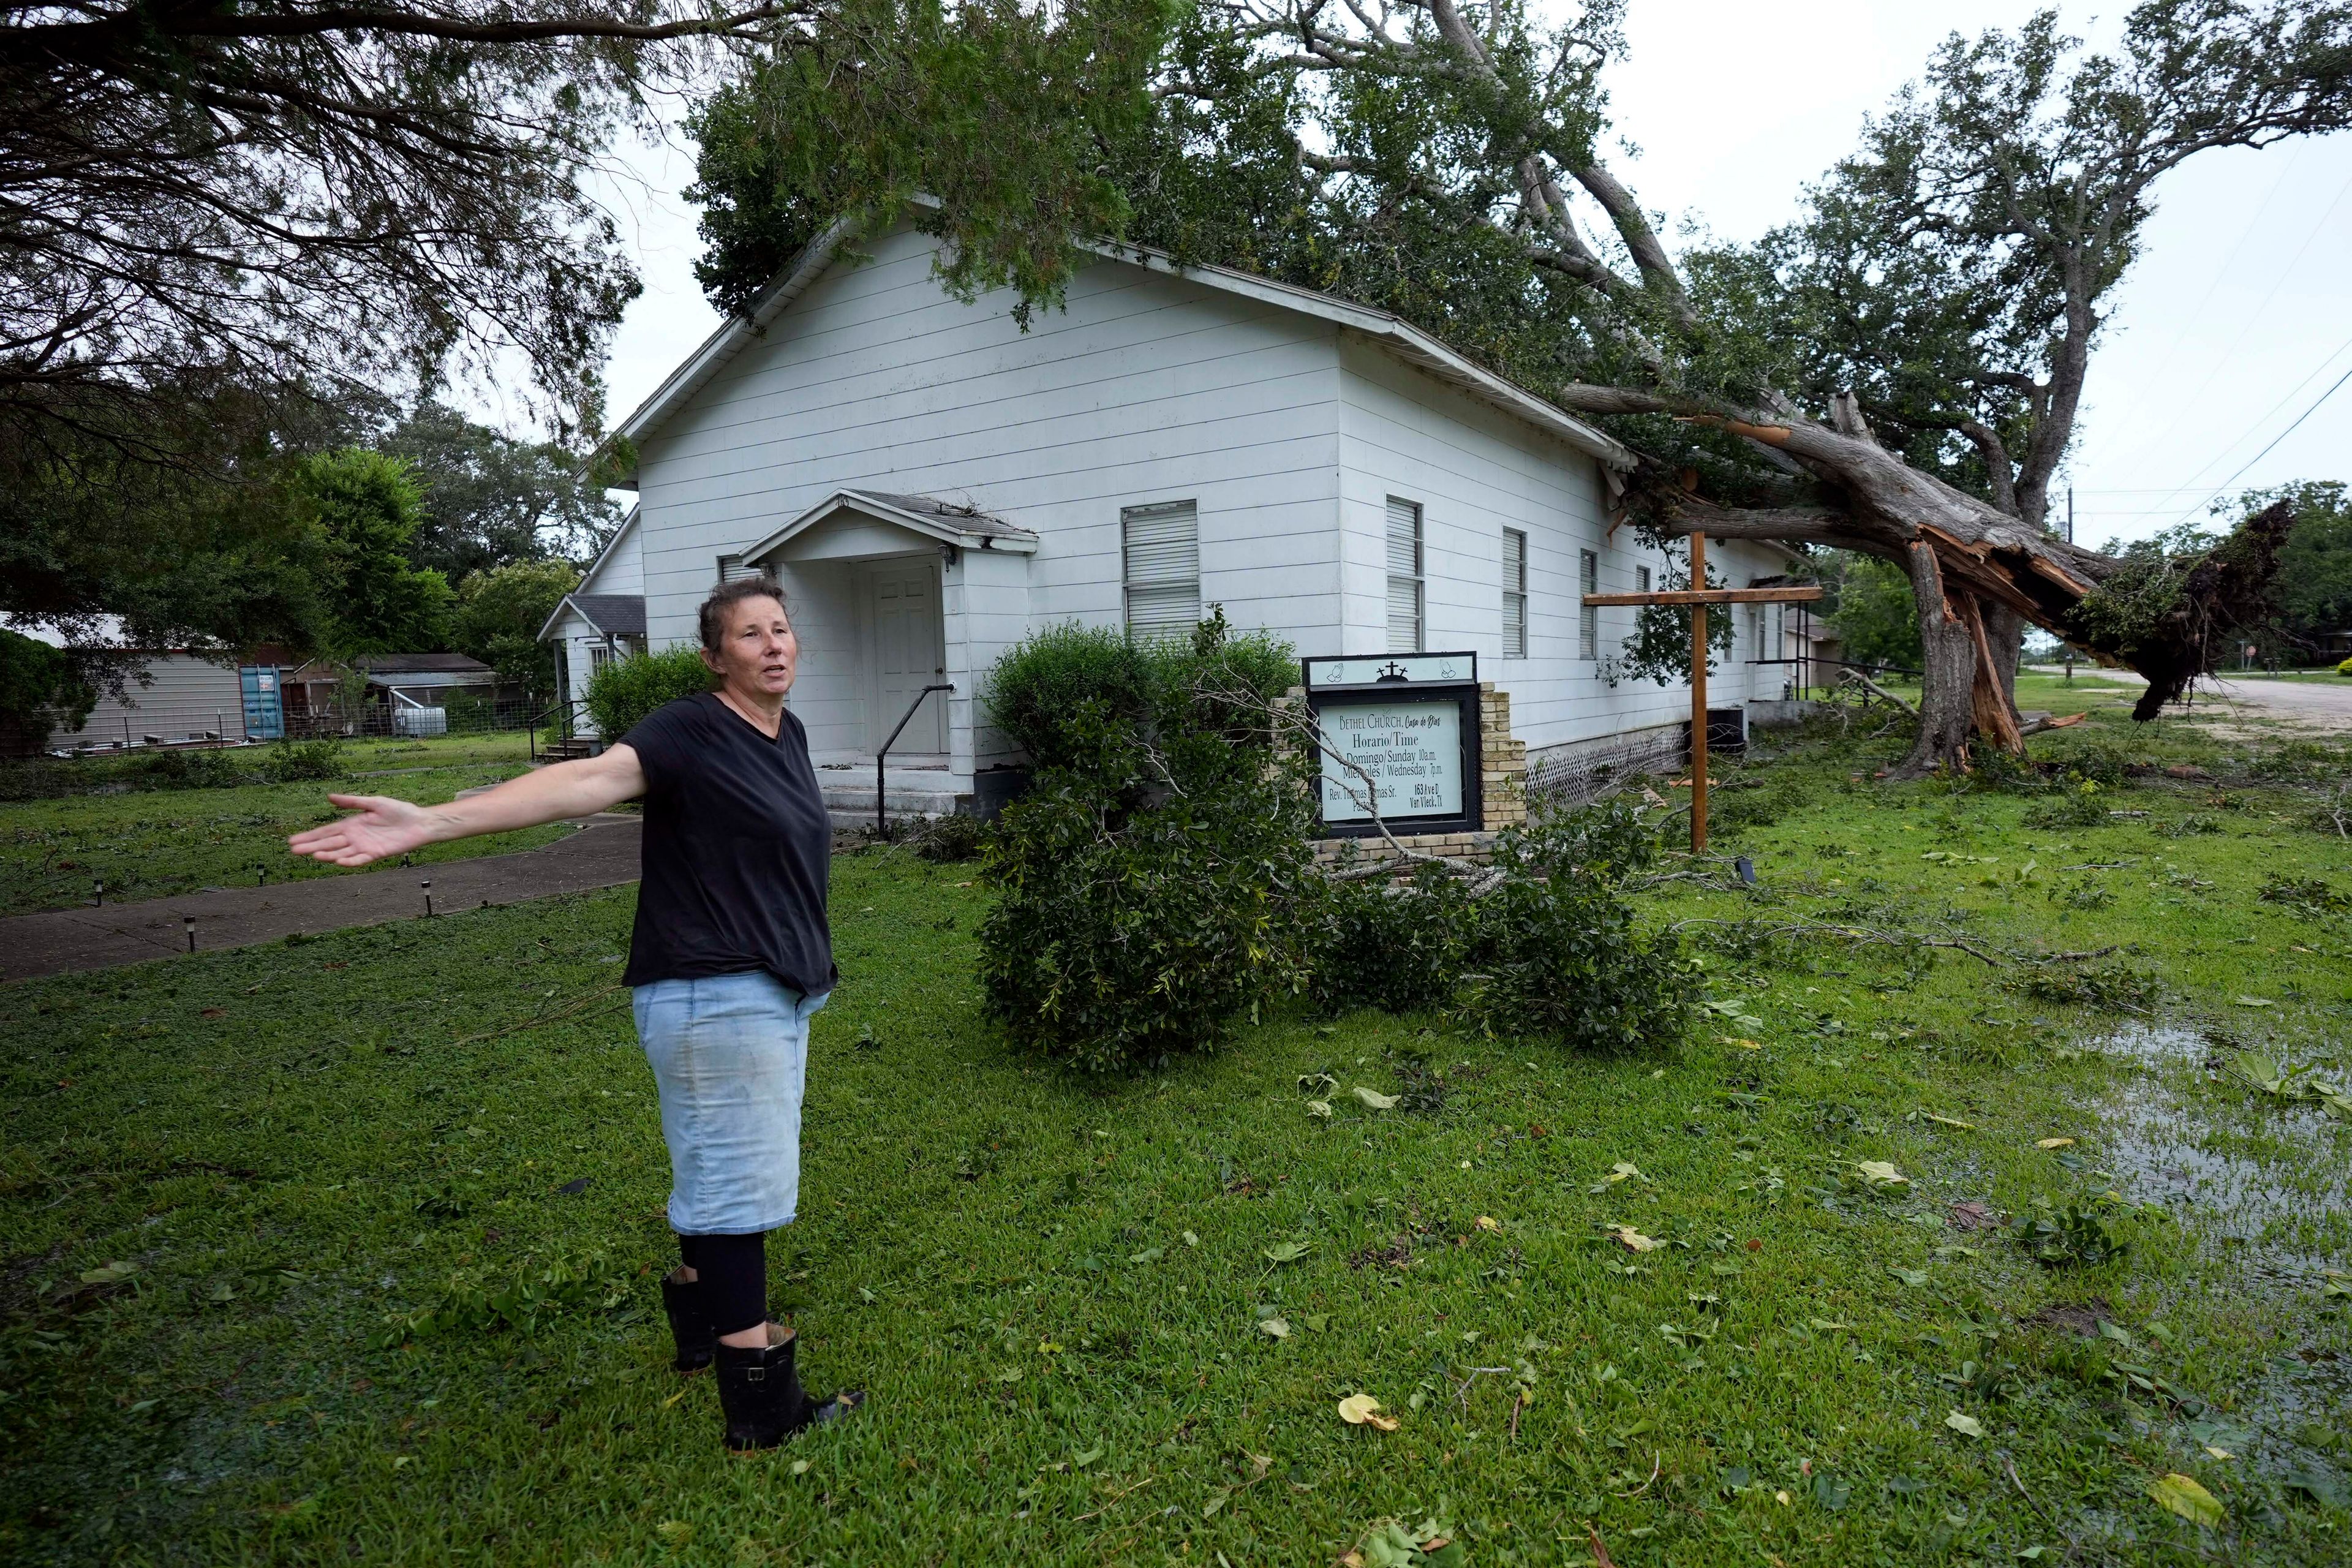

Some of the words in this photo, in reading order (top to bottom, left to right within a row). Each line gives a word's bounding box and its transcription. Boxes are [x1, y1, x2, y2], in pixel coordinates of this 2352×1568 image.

[1405, 715, 1419, 729] Casa
[1420, 716, 1427, 728] de
[1427, 714, 1441, 729] Dios
[1352, 731, 1419, 748] Horario/Time
[1387, 763, 1427, 778] Wednesday
[1330, 789, 1342, 801] Rev.
[1388, 785, 1396, 797] Sr.
[1415, 783, 1423, 795] 163
[1424, 784, 1434, 795] Ave
[1435, 783, 1439, 794] D
[1410, 797, 1420, 808] Van
[1437, 794, 1442, 807] TX
